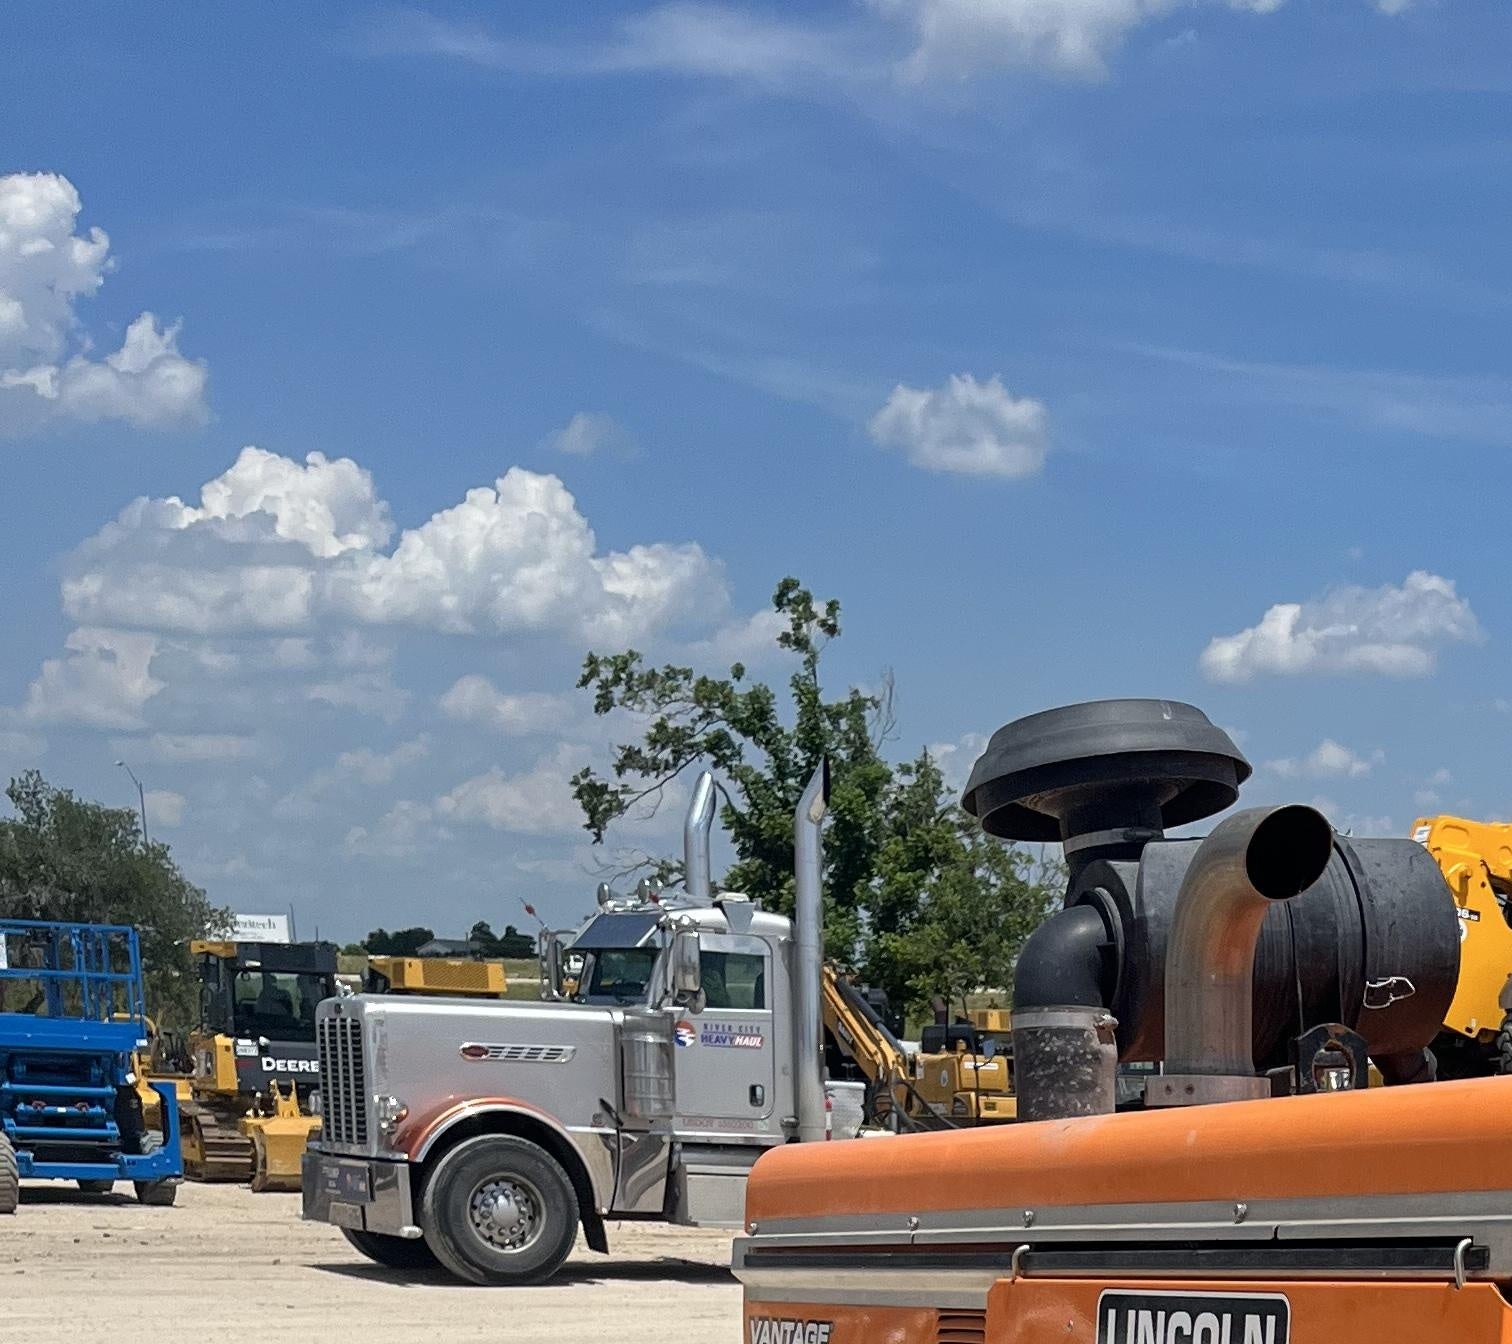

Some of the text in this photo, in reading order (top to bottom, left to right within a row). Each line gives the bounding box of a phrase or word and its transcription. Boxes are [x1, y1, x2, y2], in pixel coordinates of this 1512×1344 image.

[703, 1023, 761, 1034] RIVER CITY
[262, 1056, 319, 1072] DEERE
